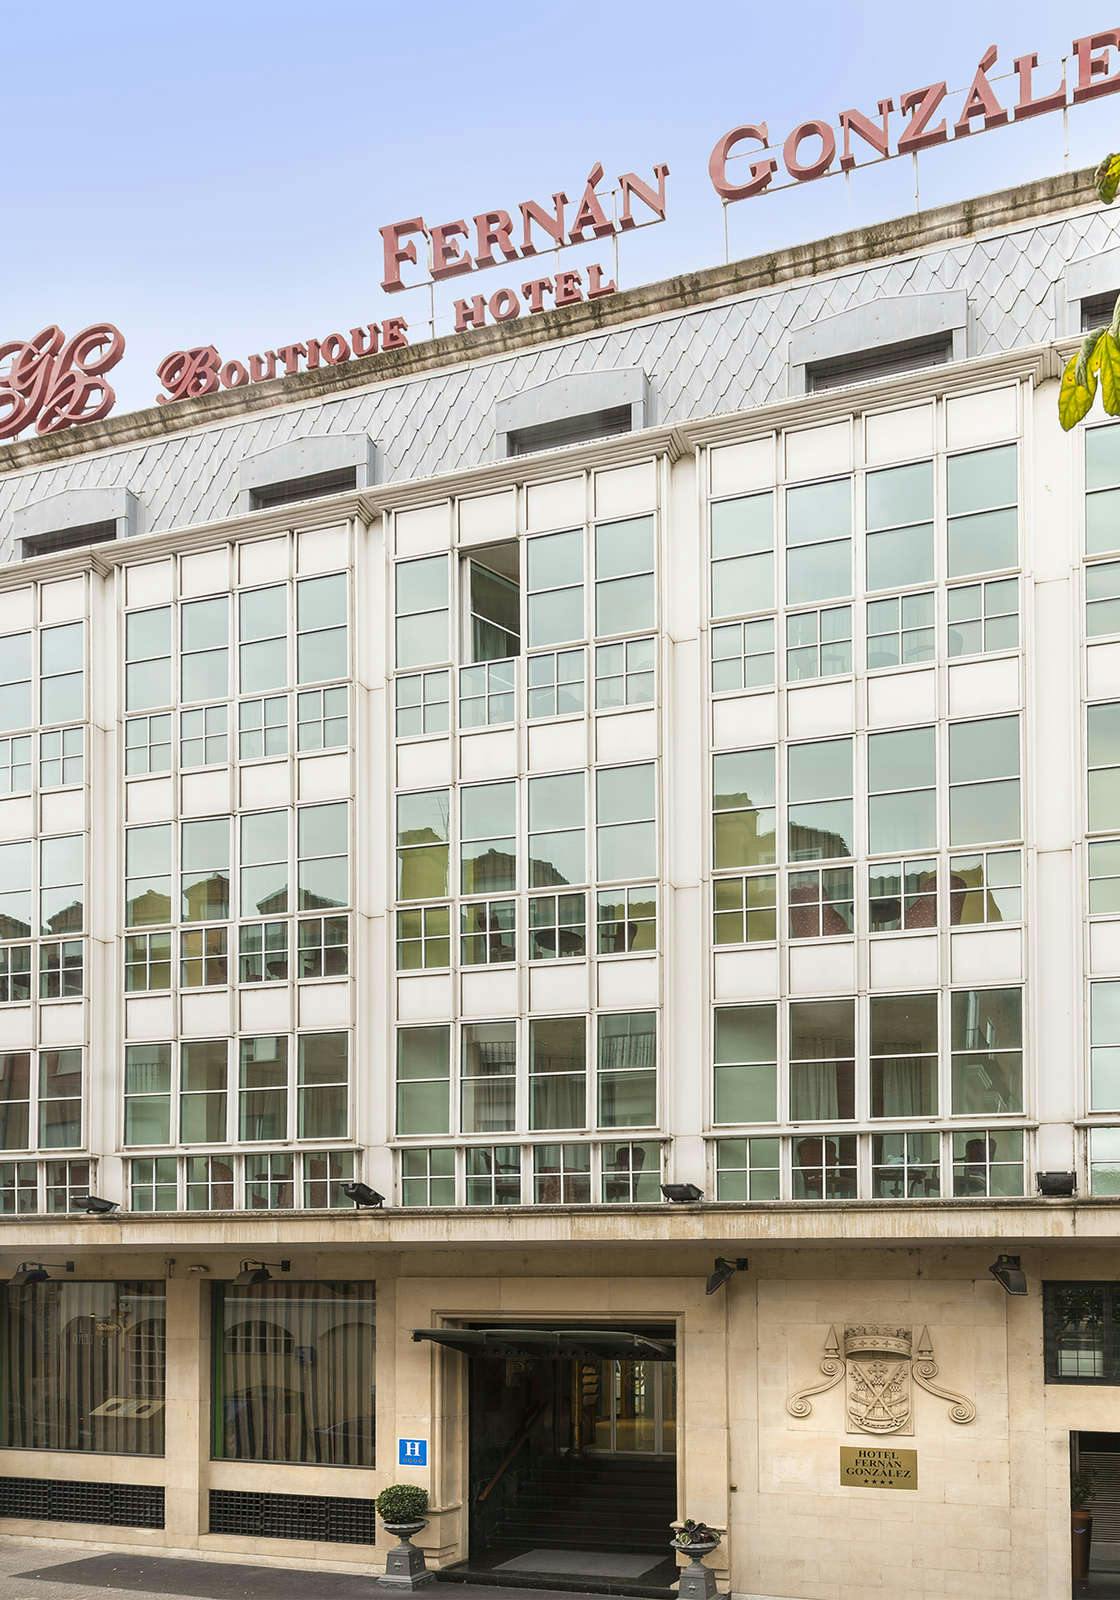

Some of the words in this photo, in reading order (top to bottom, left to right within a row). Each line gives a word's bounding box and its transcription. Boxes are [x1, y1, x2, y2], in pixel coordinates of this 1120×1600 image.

[378, 160, 671, 294] FERNÁN
[155, 316, 409, 405] BOUTIQUE
[453, 263, 617, 333] HOTEL
[405, 1441, 421, 1457] H
[858, 1450, 900, 1460] HOTEL
